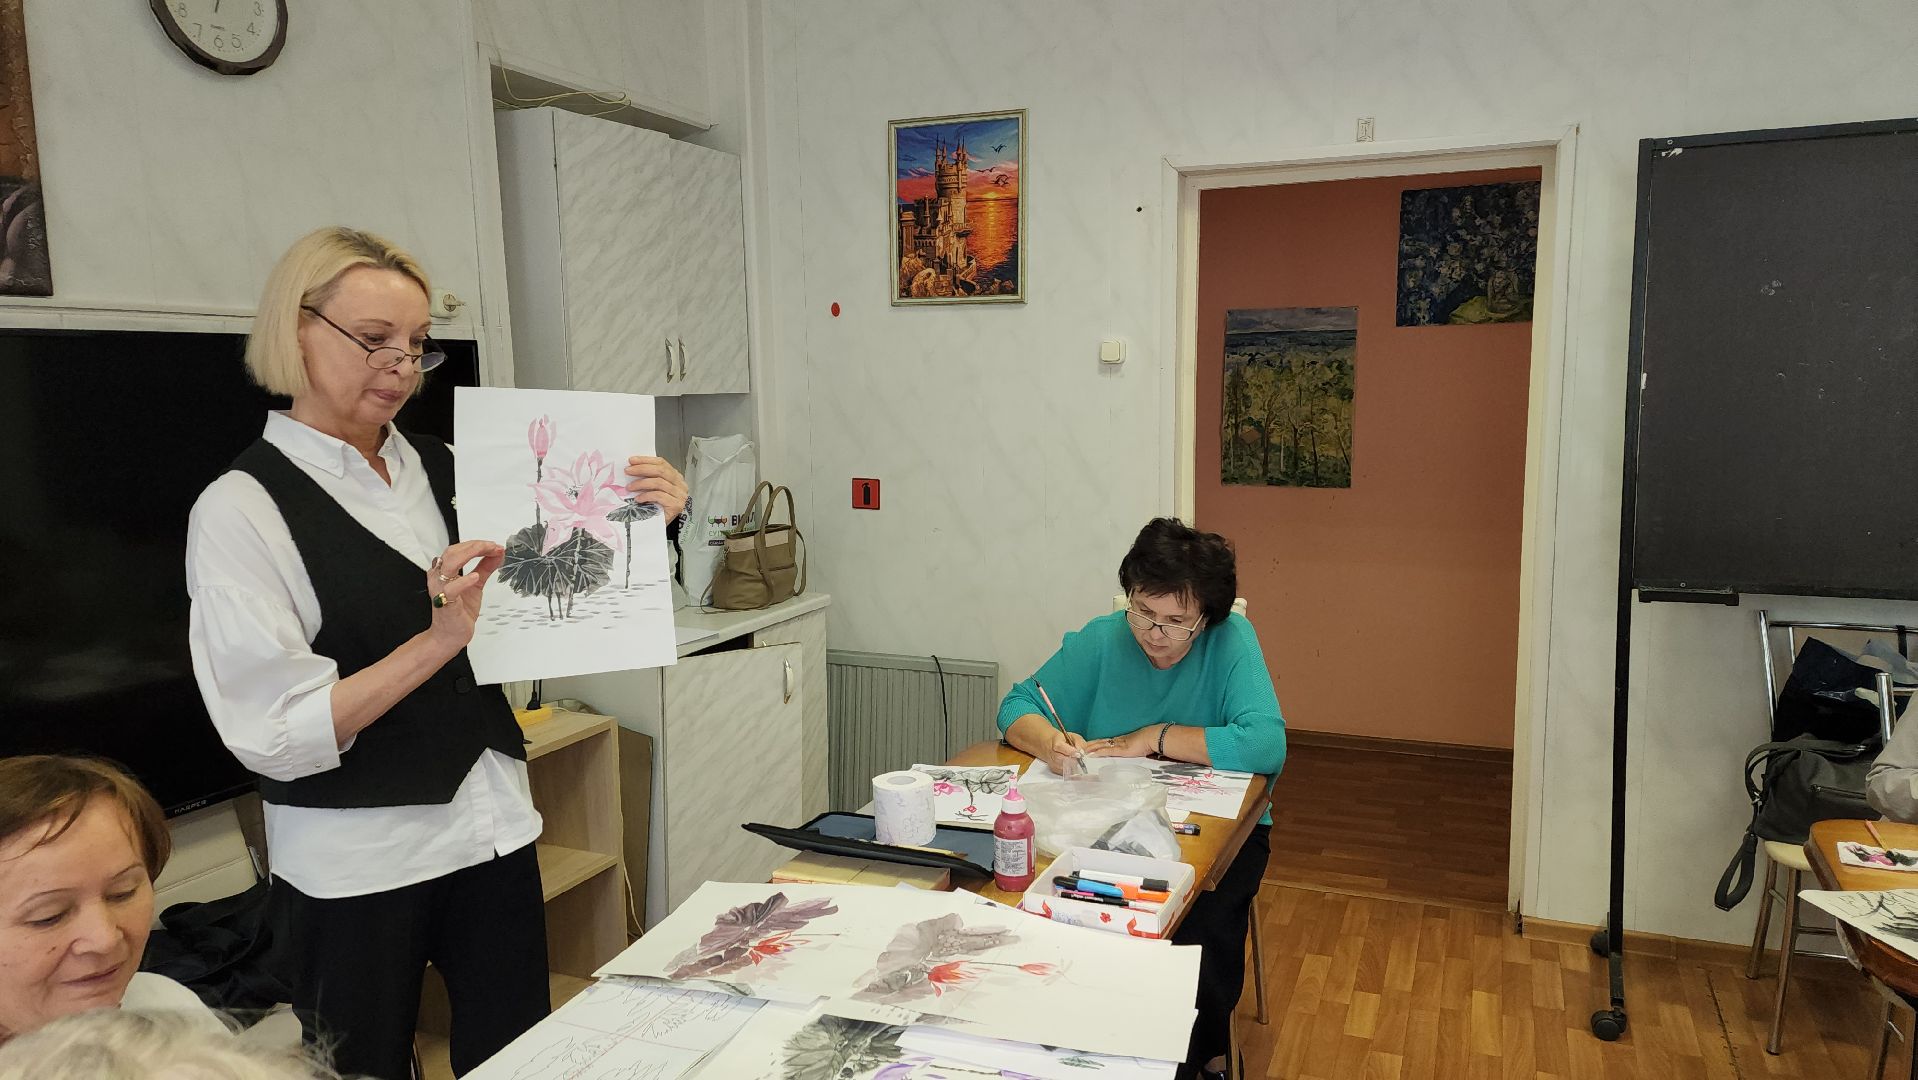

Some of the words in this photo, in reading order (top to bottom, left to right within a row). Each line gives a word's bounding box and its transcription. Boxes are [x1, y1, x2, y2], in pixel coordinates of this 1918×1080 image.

[179, 2, 188, 18] 8
[254, 1, 261, 16] 3
[192, 22, 202, 40] 7
[246, 22, 255, 34] 4
[214, 35, 223, 48] 6
[231, 33, 242, 48] 5
[174, 799, 207, 815] HARPER
